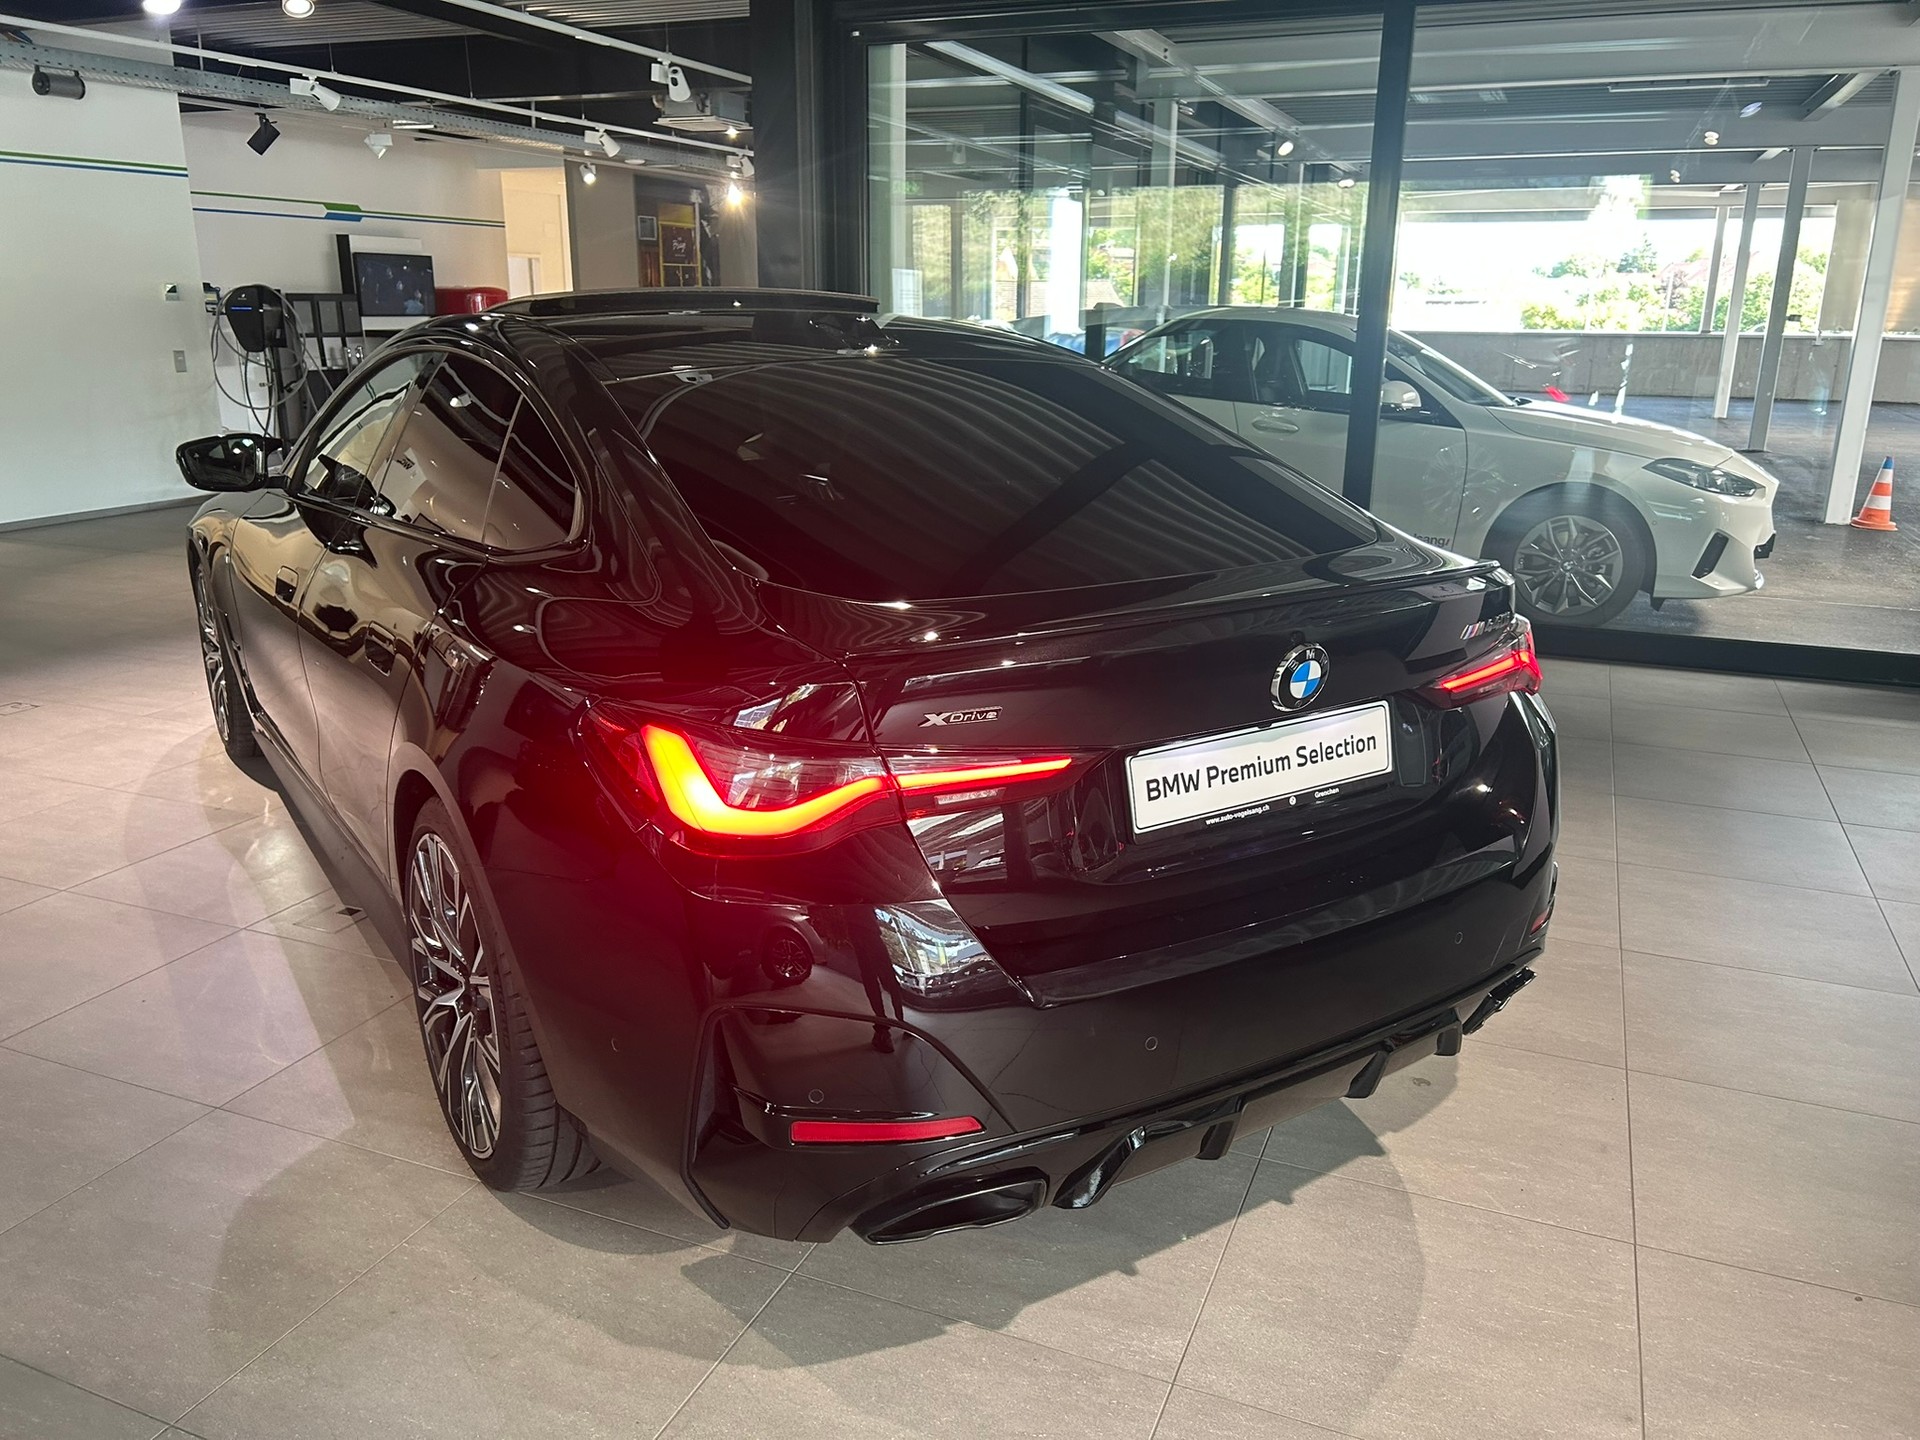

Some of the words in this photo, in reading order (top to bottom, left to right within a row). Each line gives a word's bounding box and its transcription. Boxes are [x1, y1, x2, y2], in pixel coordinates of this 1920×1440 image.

[1146, 769, 1200, 802] BMW
[1206, 753, 1292, 789] Premium
[1296, 734, 1378, 768] Selection
[1314, 787, 1340, 799] Grenchen
[1205, 804, 1270, 826] www.auto-vogelsang.ch
